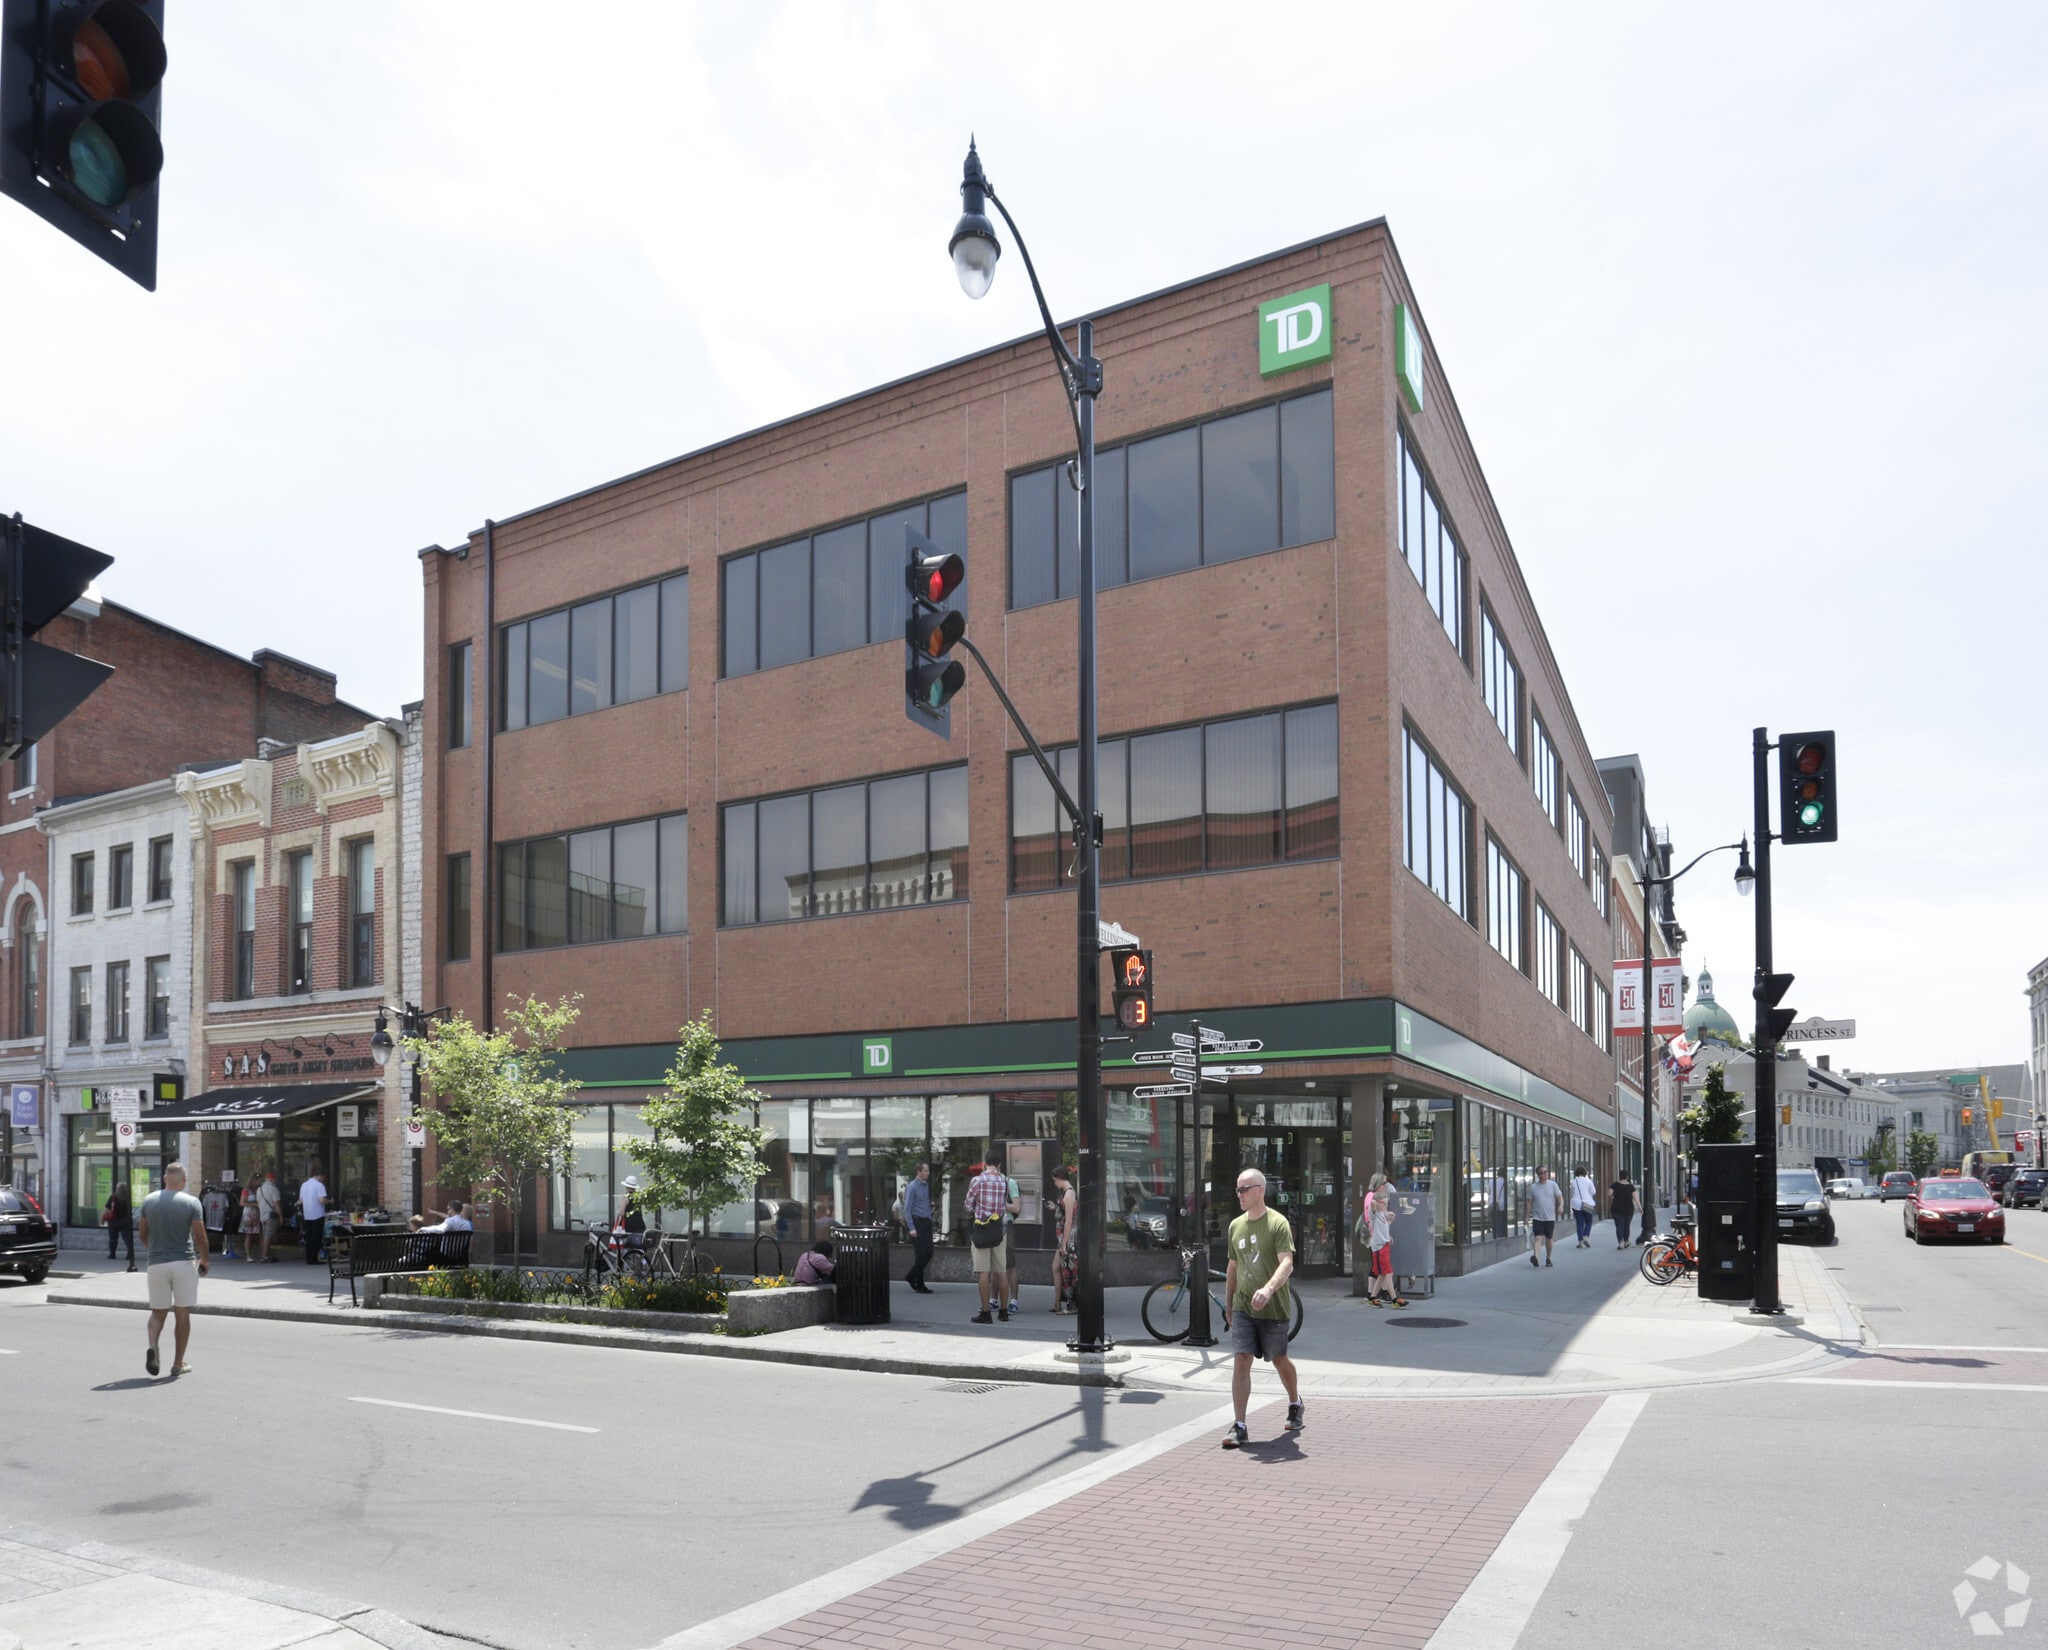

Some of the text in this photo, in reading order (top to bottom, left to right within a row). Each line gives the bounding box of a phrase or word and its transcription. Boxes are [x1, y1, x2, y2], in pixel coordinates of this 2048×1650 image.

[1266, 301, 1323, 354] TD
[1136, 1001, 1146, 1023] 3
[1786, 1027, 1837, 1040] RINCESS
[866, 1045, 889, 1067] TD
[234, 1119, 264, 1130] SURPLUS
